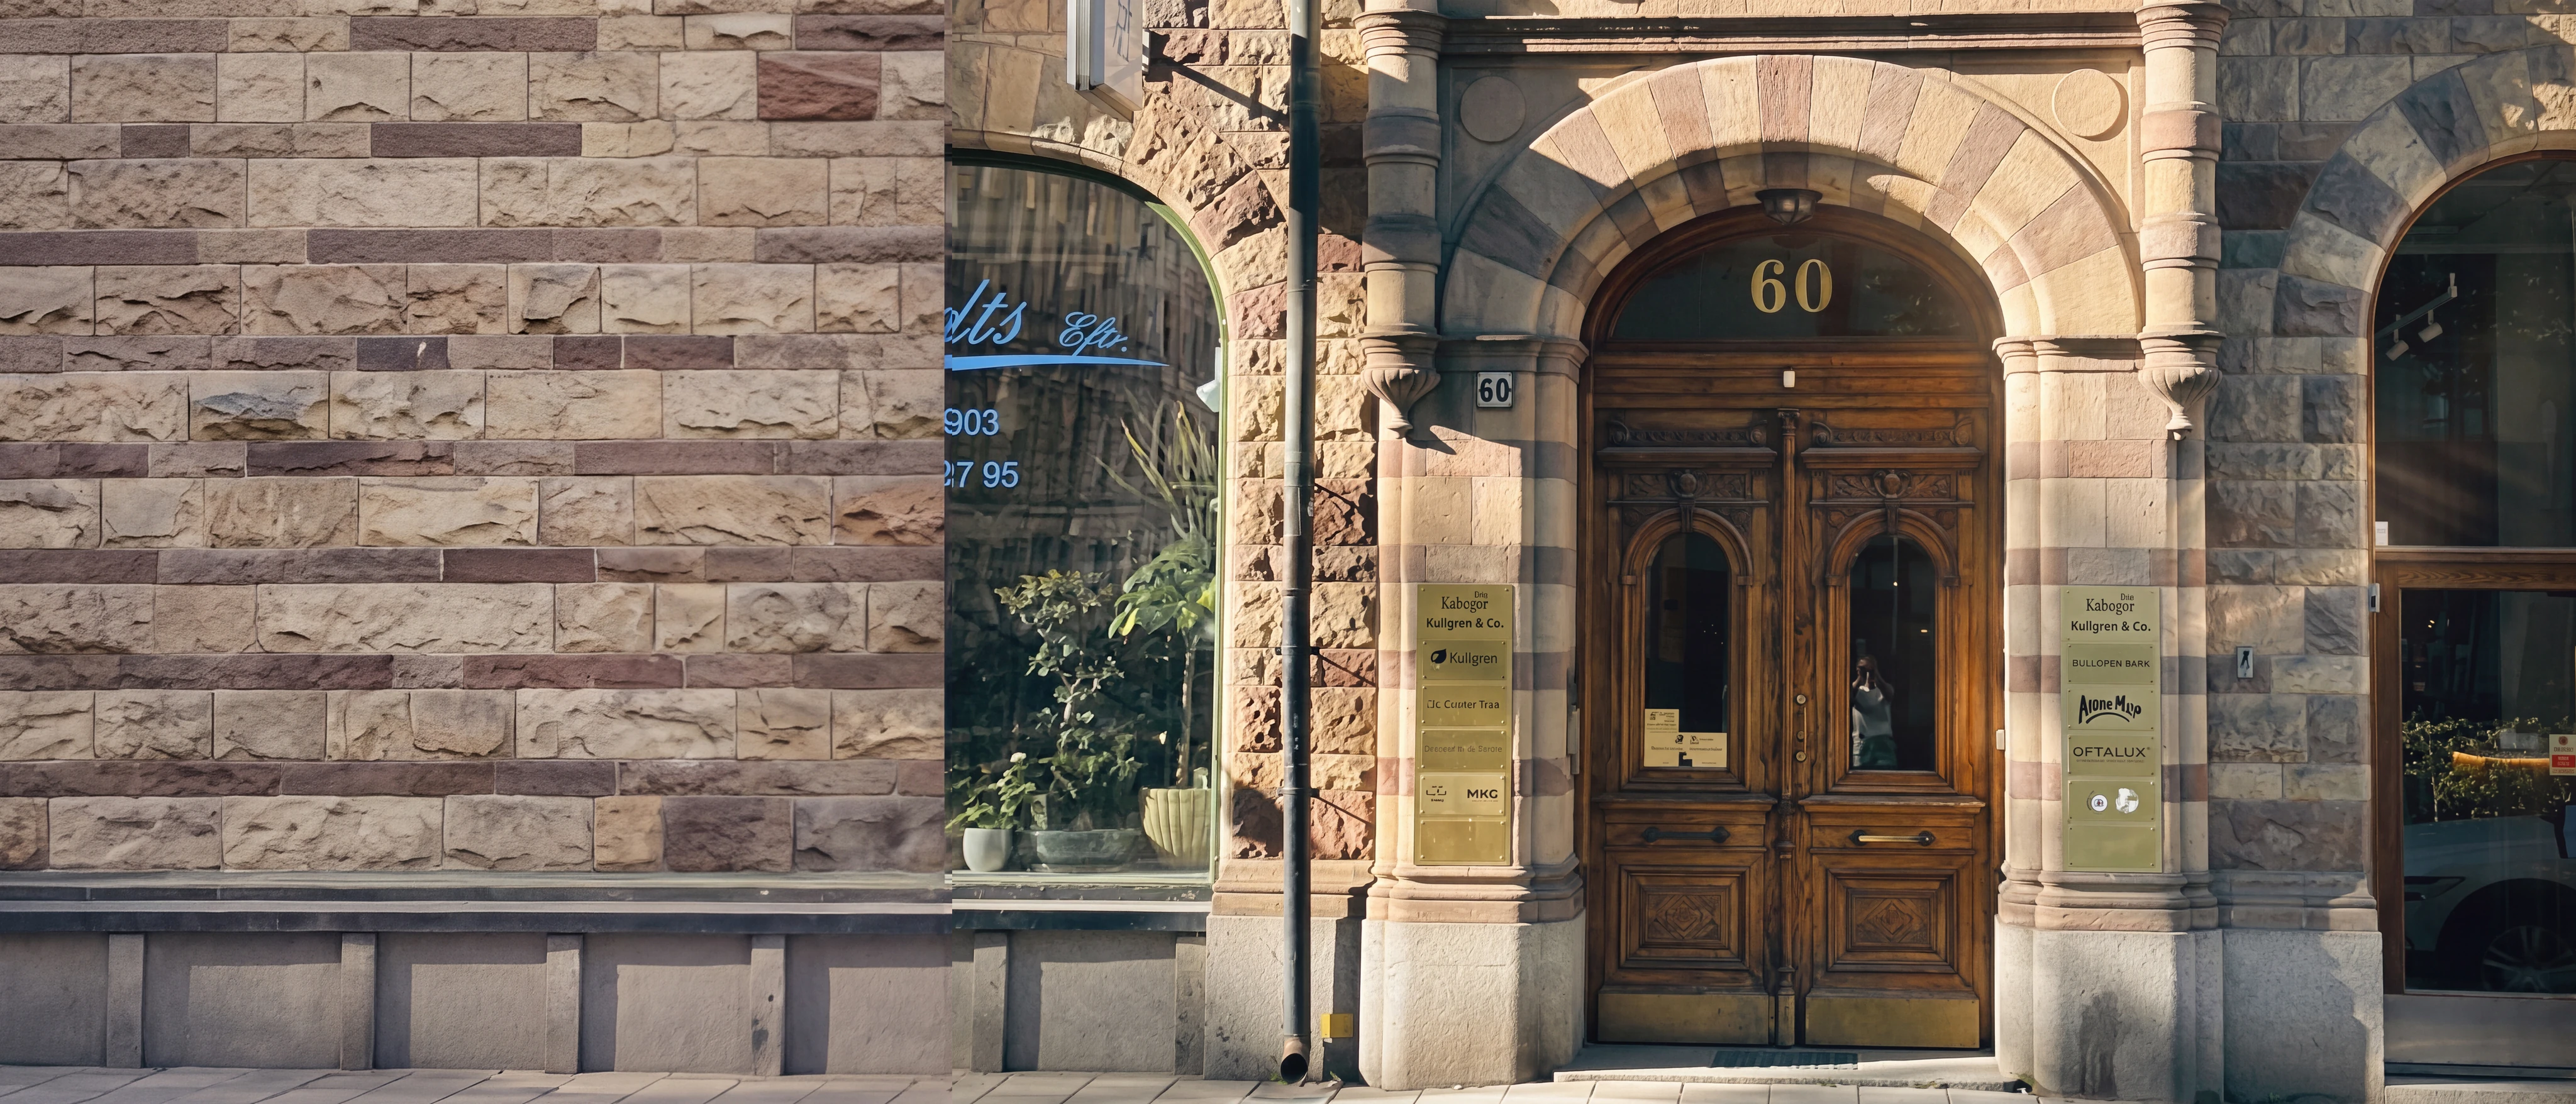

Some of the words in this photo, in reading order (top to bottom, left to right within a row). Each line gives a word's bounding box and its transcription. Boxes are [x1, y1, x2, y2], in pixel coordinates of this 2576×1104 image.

[1751, 258, 1833, 314] 60
[1480, 377, 1510, 403] 60
[982, 461, 1019, 489] 95
[1441, 596, 1489, 614] Kabogor
[2085, 599, 2135, 615] Kabogor
[1426, 617, 1472, 631] Kullgren
[1475, 617, 1484, 628] &
[1486, 618, 1504, 628] Co.
[2071, 621, 2118, 634] Kullgren
[2121, 621, 2130, 631] &
[2133, 621, 2151, 631] Co.
[1450, 652, 1497, 666] Kullgren
[2072, 660, 2123, 668] BULLOPEN
[1467, 789, 1499, 799] MKG
